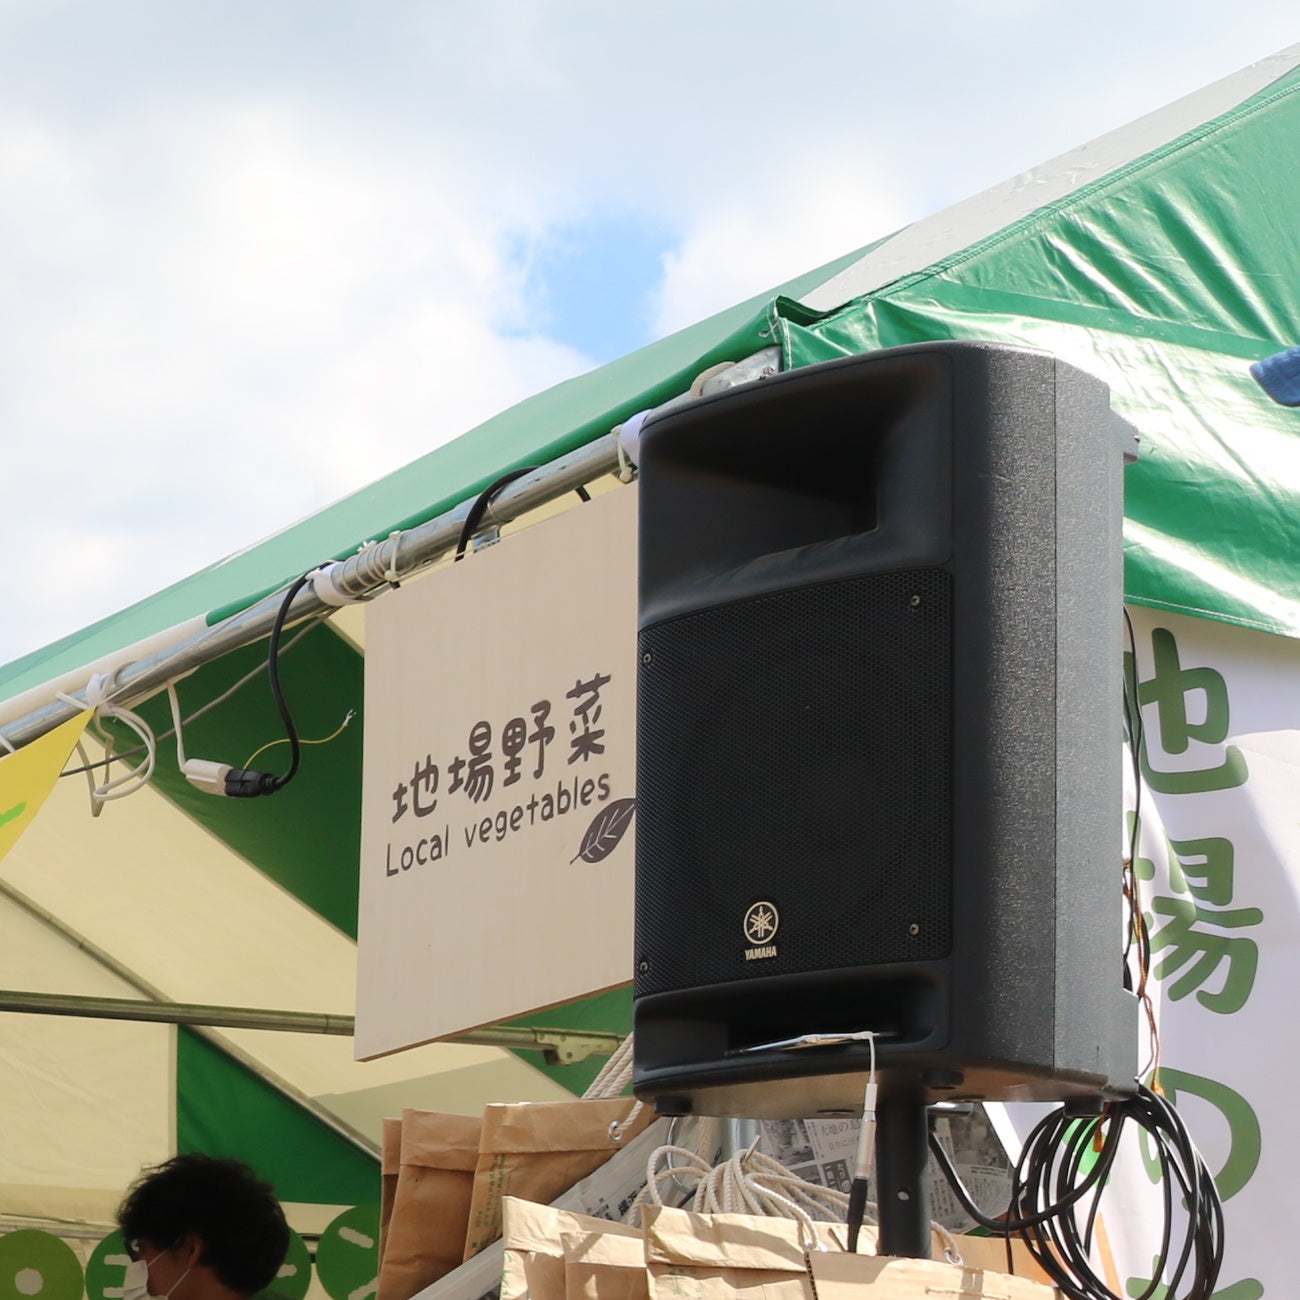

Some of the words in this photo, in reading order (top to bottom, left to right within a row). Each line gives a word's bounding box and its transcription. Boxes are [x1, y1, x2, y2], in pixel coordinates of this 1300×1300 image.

[389, 672, 612, 824] 地場野菜
[385, 825, 450, 878] Local
[464, 769, 612, 846] vegetables
[744, 945, 778, 961] YAMAHA
